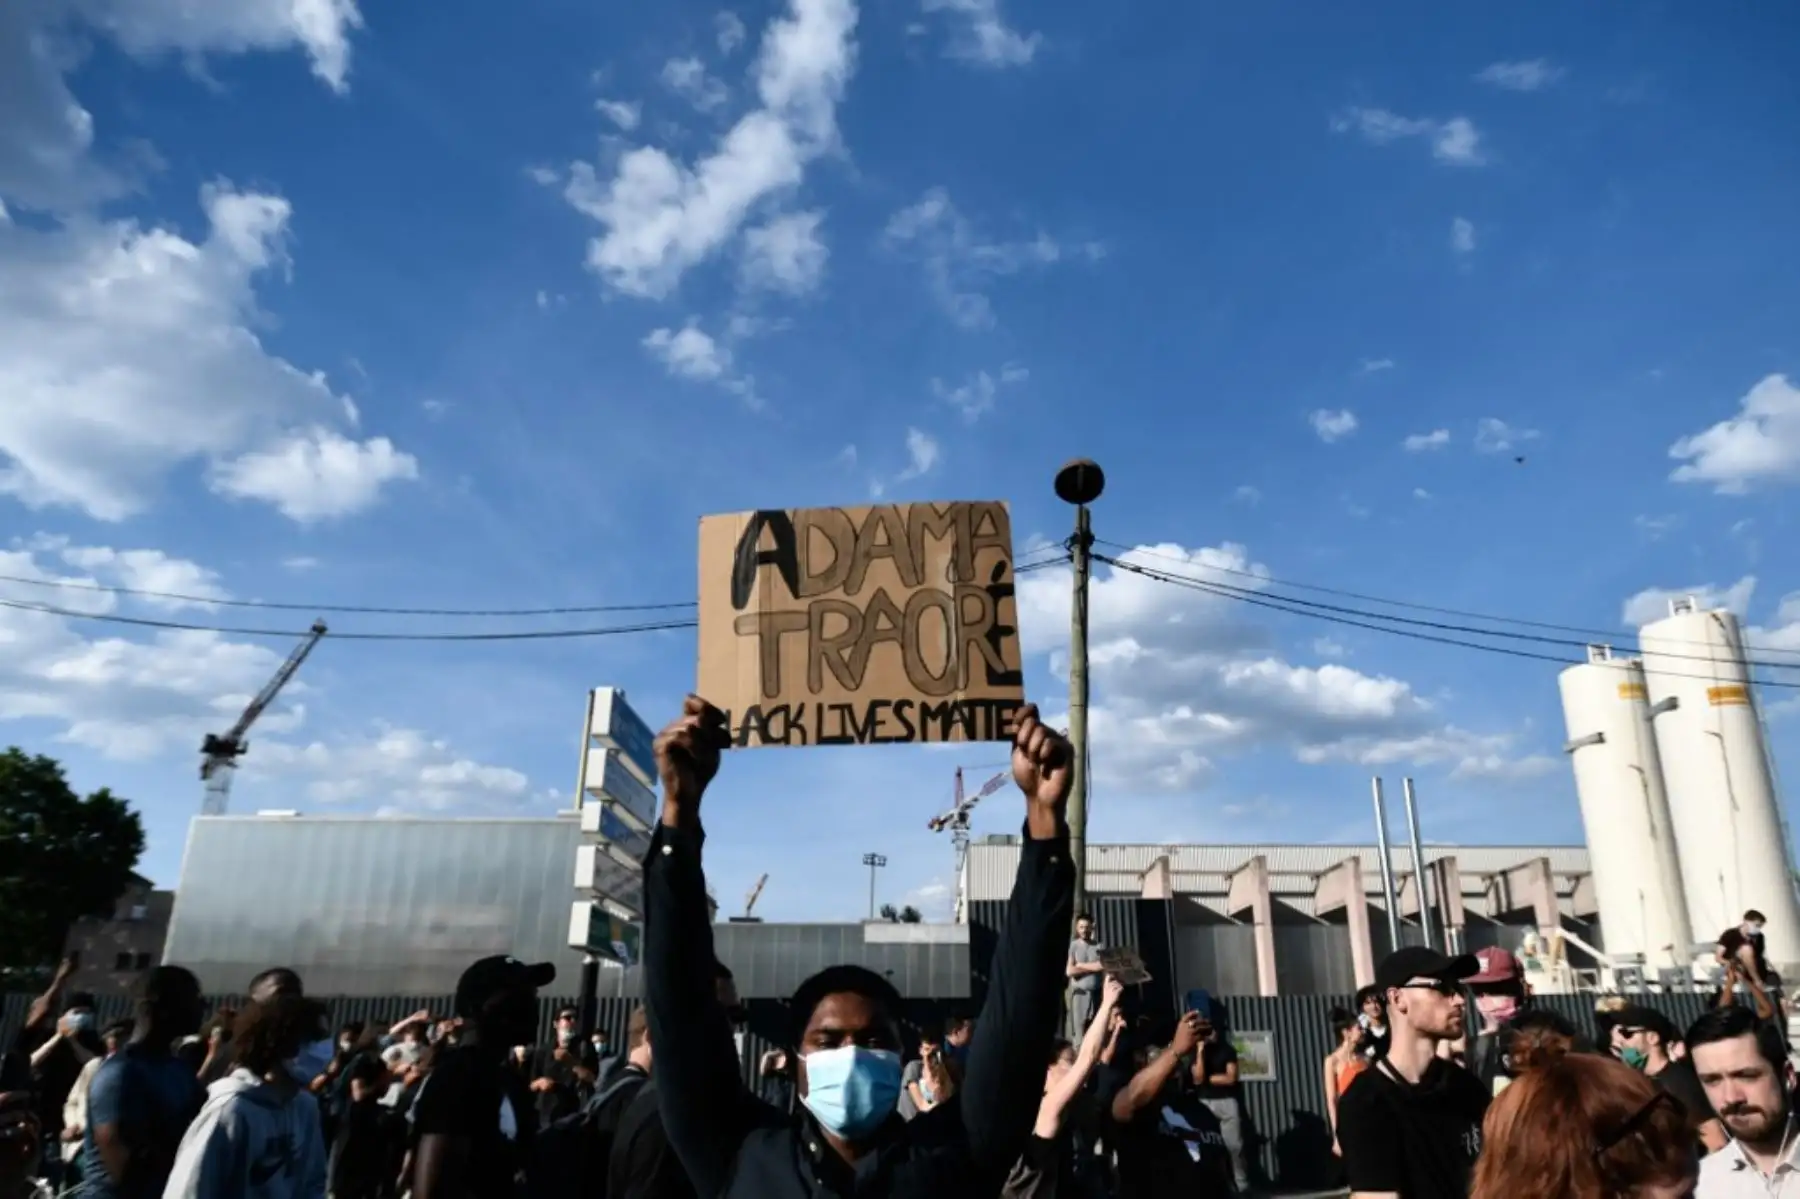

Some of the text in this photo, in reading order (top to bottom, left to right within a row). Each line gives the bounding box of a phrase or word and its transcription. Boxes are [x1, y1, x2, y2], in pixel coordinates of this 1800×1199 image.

[731, 500, 1012, 610] ADAMA
[733, 559, 1023, 698] TRAORÉ
[725, 702, 807, 746] LACK
[816, 699, 916, 744] LIVES
